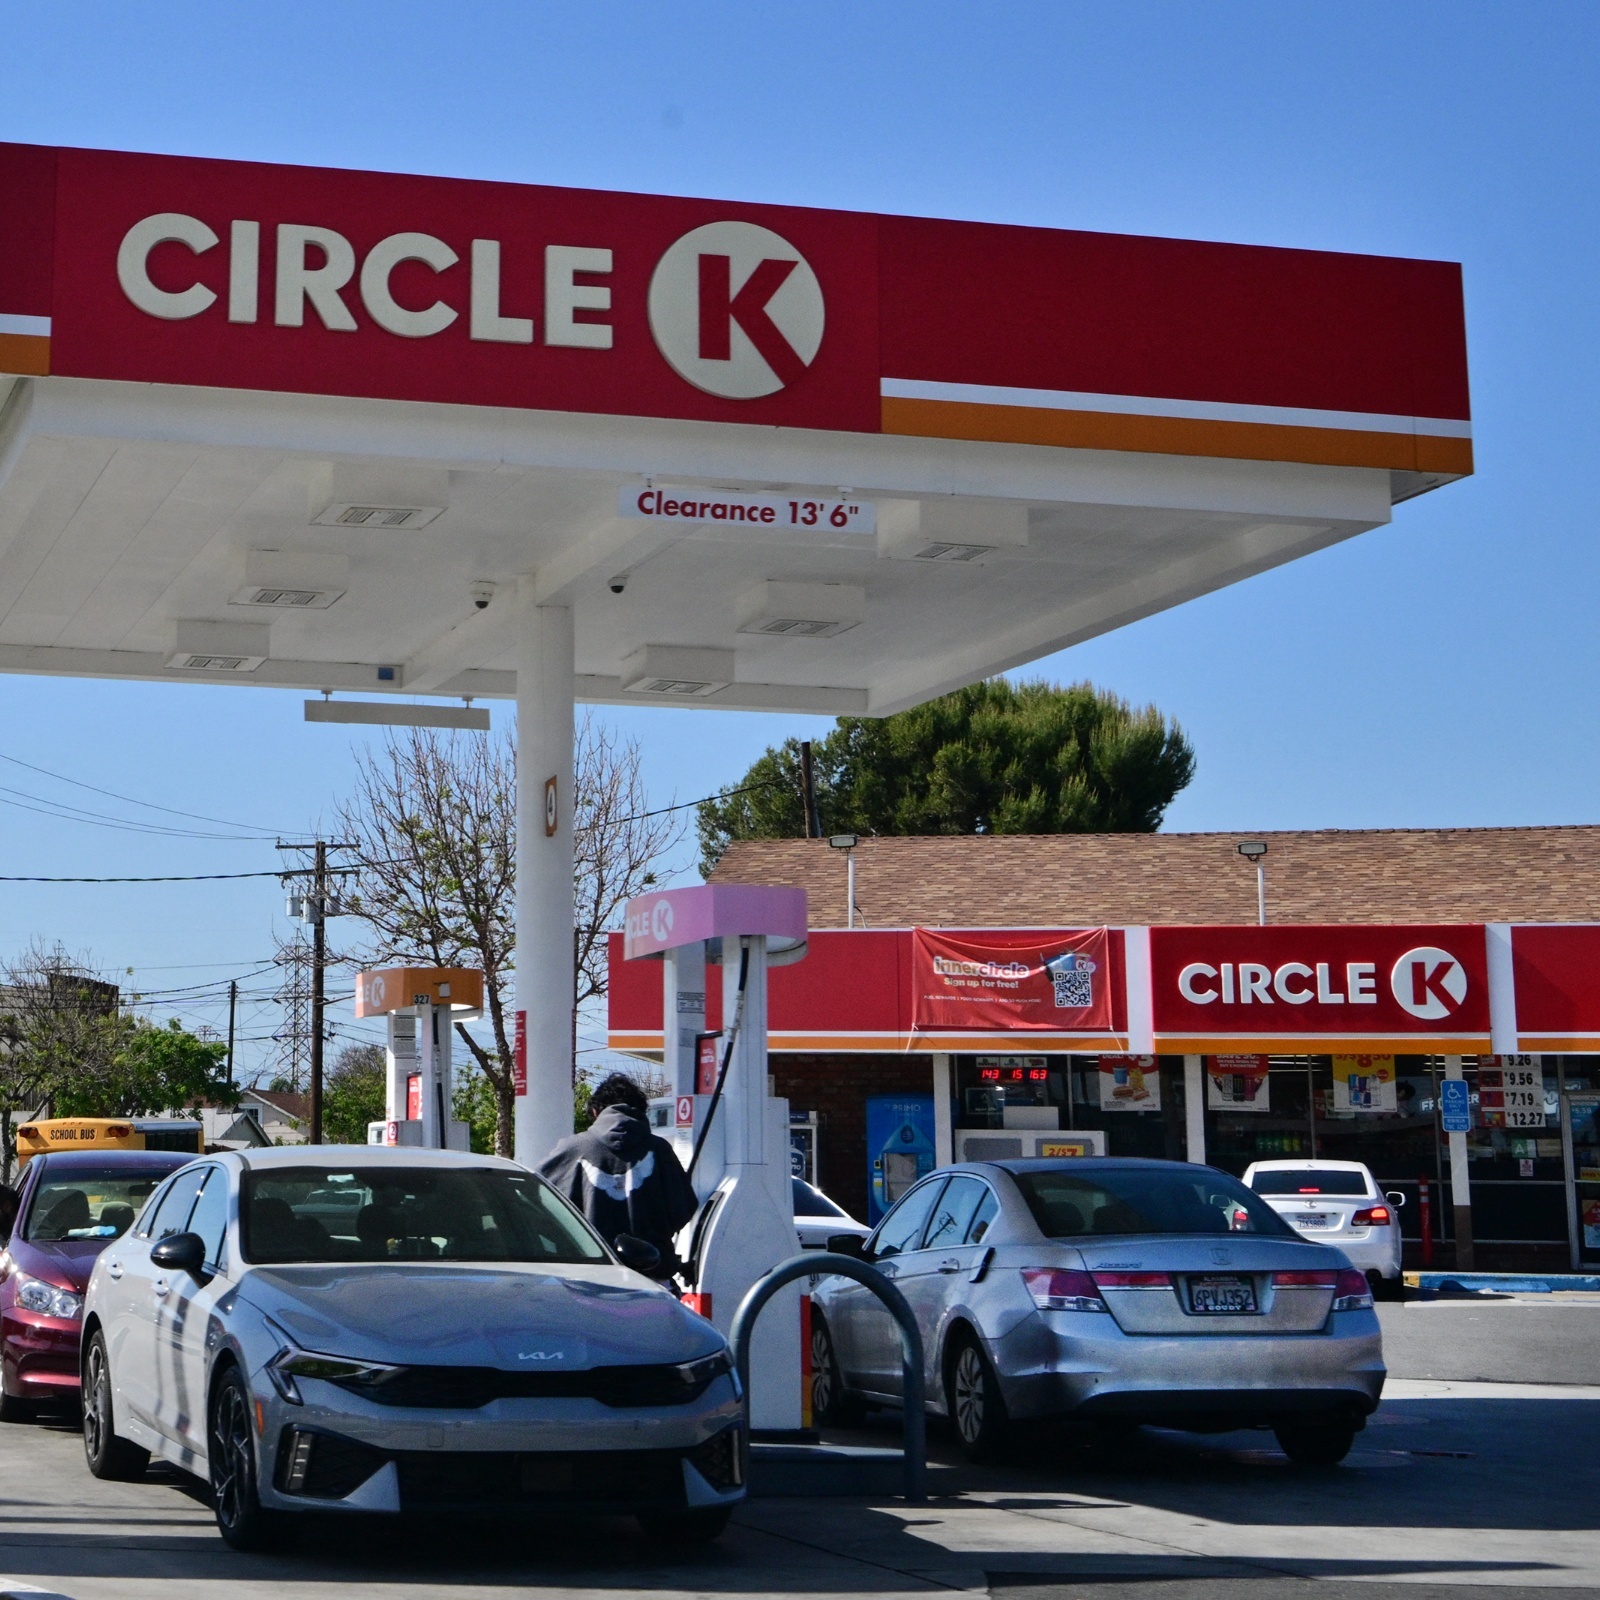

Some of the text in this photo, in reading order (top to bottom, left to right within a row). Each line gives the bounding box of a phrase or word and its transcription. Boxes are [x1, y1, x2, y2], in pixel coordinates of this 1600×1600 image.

[117, 212, 812, 391] CIRCLE K
[637, 490, 859, 528] Clearance 13' 6"
[934, 956, 1029, 978] innercircle
[944, 977, 1019, 989] Sign up for free!
[1178, 960, 1463, 1017] CIRCLE K
[413, 994, 430, 1004] 327
[981, 1069, 1047, 1079] 143 15 163
[1504, 1071, 1534, 1086] $9.56
[1505, 1092, 1534, 1106] $7.19
[680, 1101, 688, 1116] 4
[892, 1103, 921, 1112] PRIMO
[1506, 1111, 1543, 1126] $12.27
[50, 1128, 95, 1140] SCHOOL BUS
[1515, 1143, 1525, 1154] A
[1195, 1288, 1253, 1306] 6PVJ352
